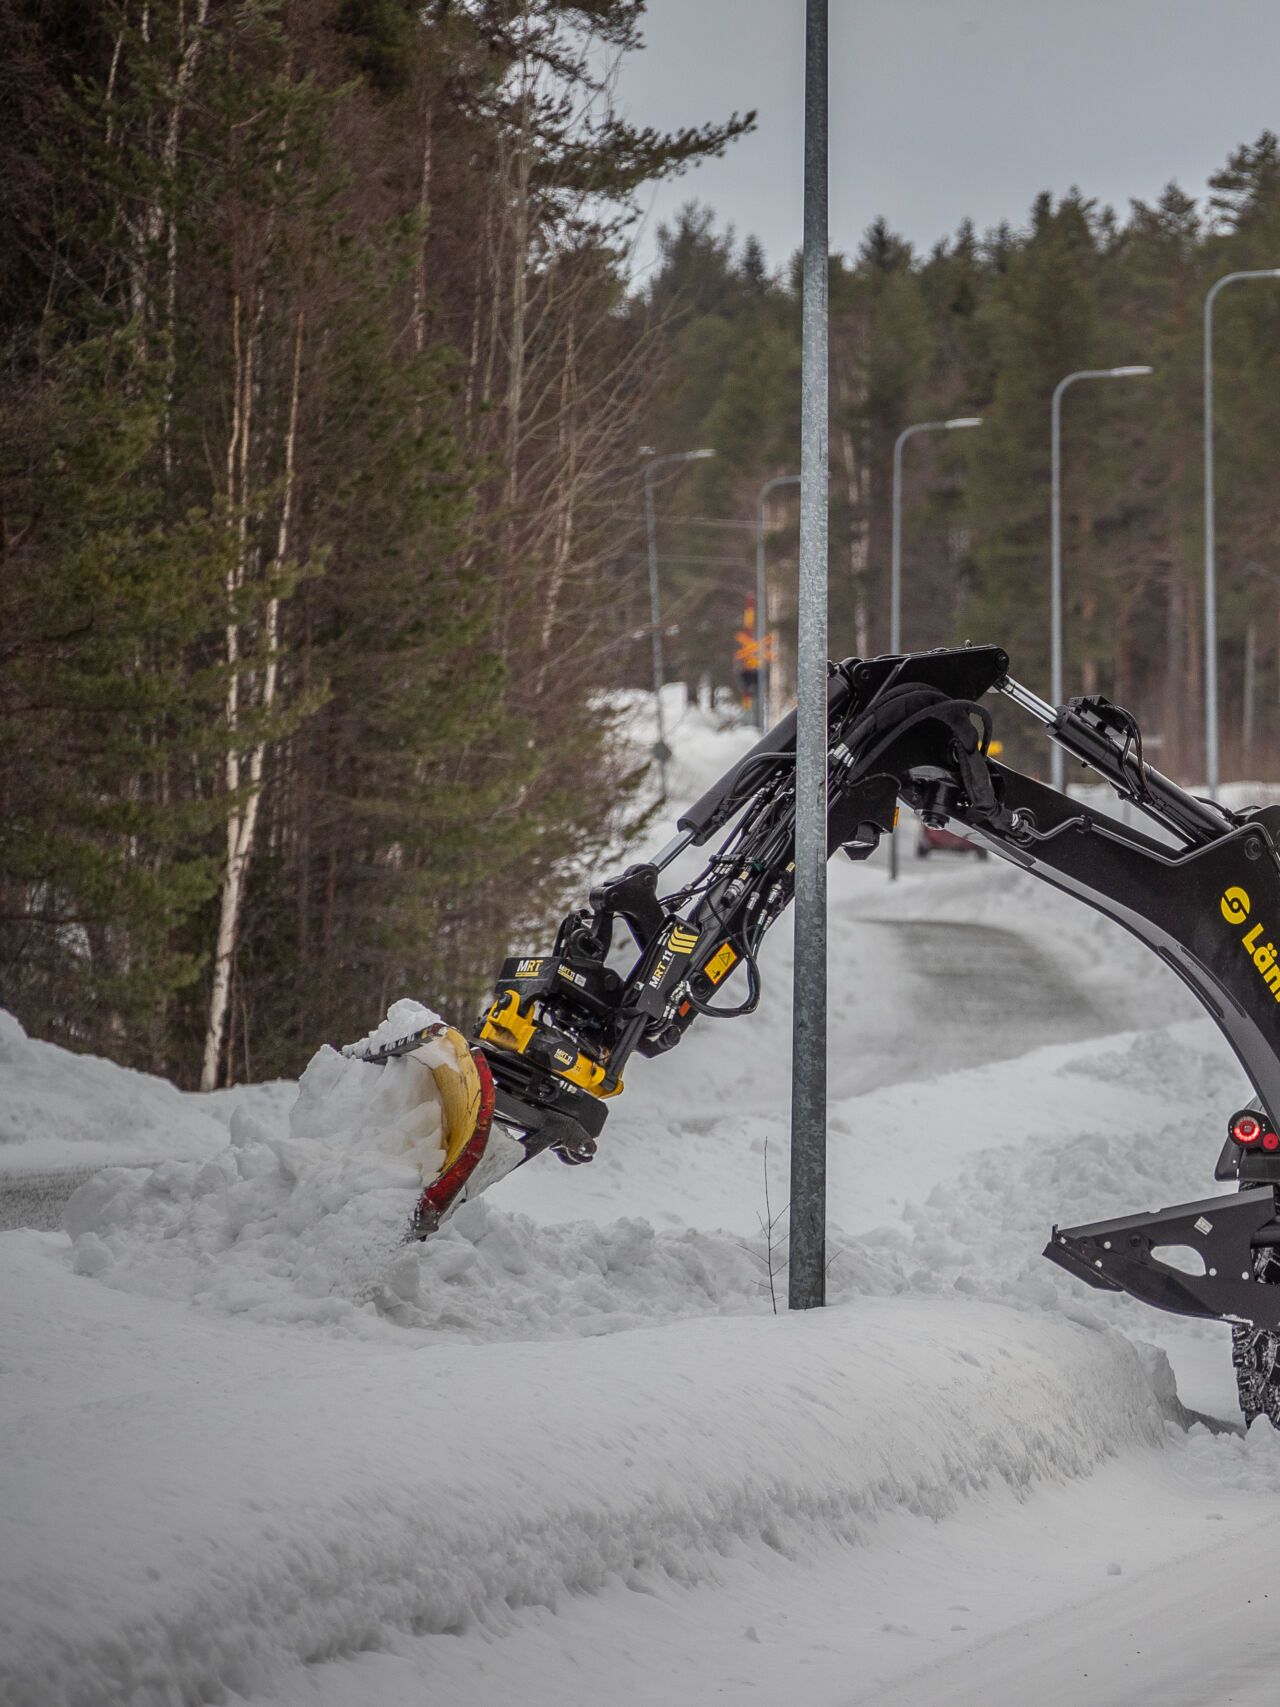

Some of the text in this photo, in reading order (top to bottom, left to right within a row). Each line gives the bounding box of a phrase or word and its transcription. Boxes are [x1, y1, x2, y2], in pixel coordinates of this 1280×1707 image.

[516, 959, 544, 972] MRT
[648, 961, 666, 988] MRT
[662, 950, 673, 962] 11
